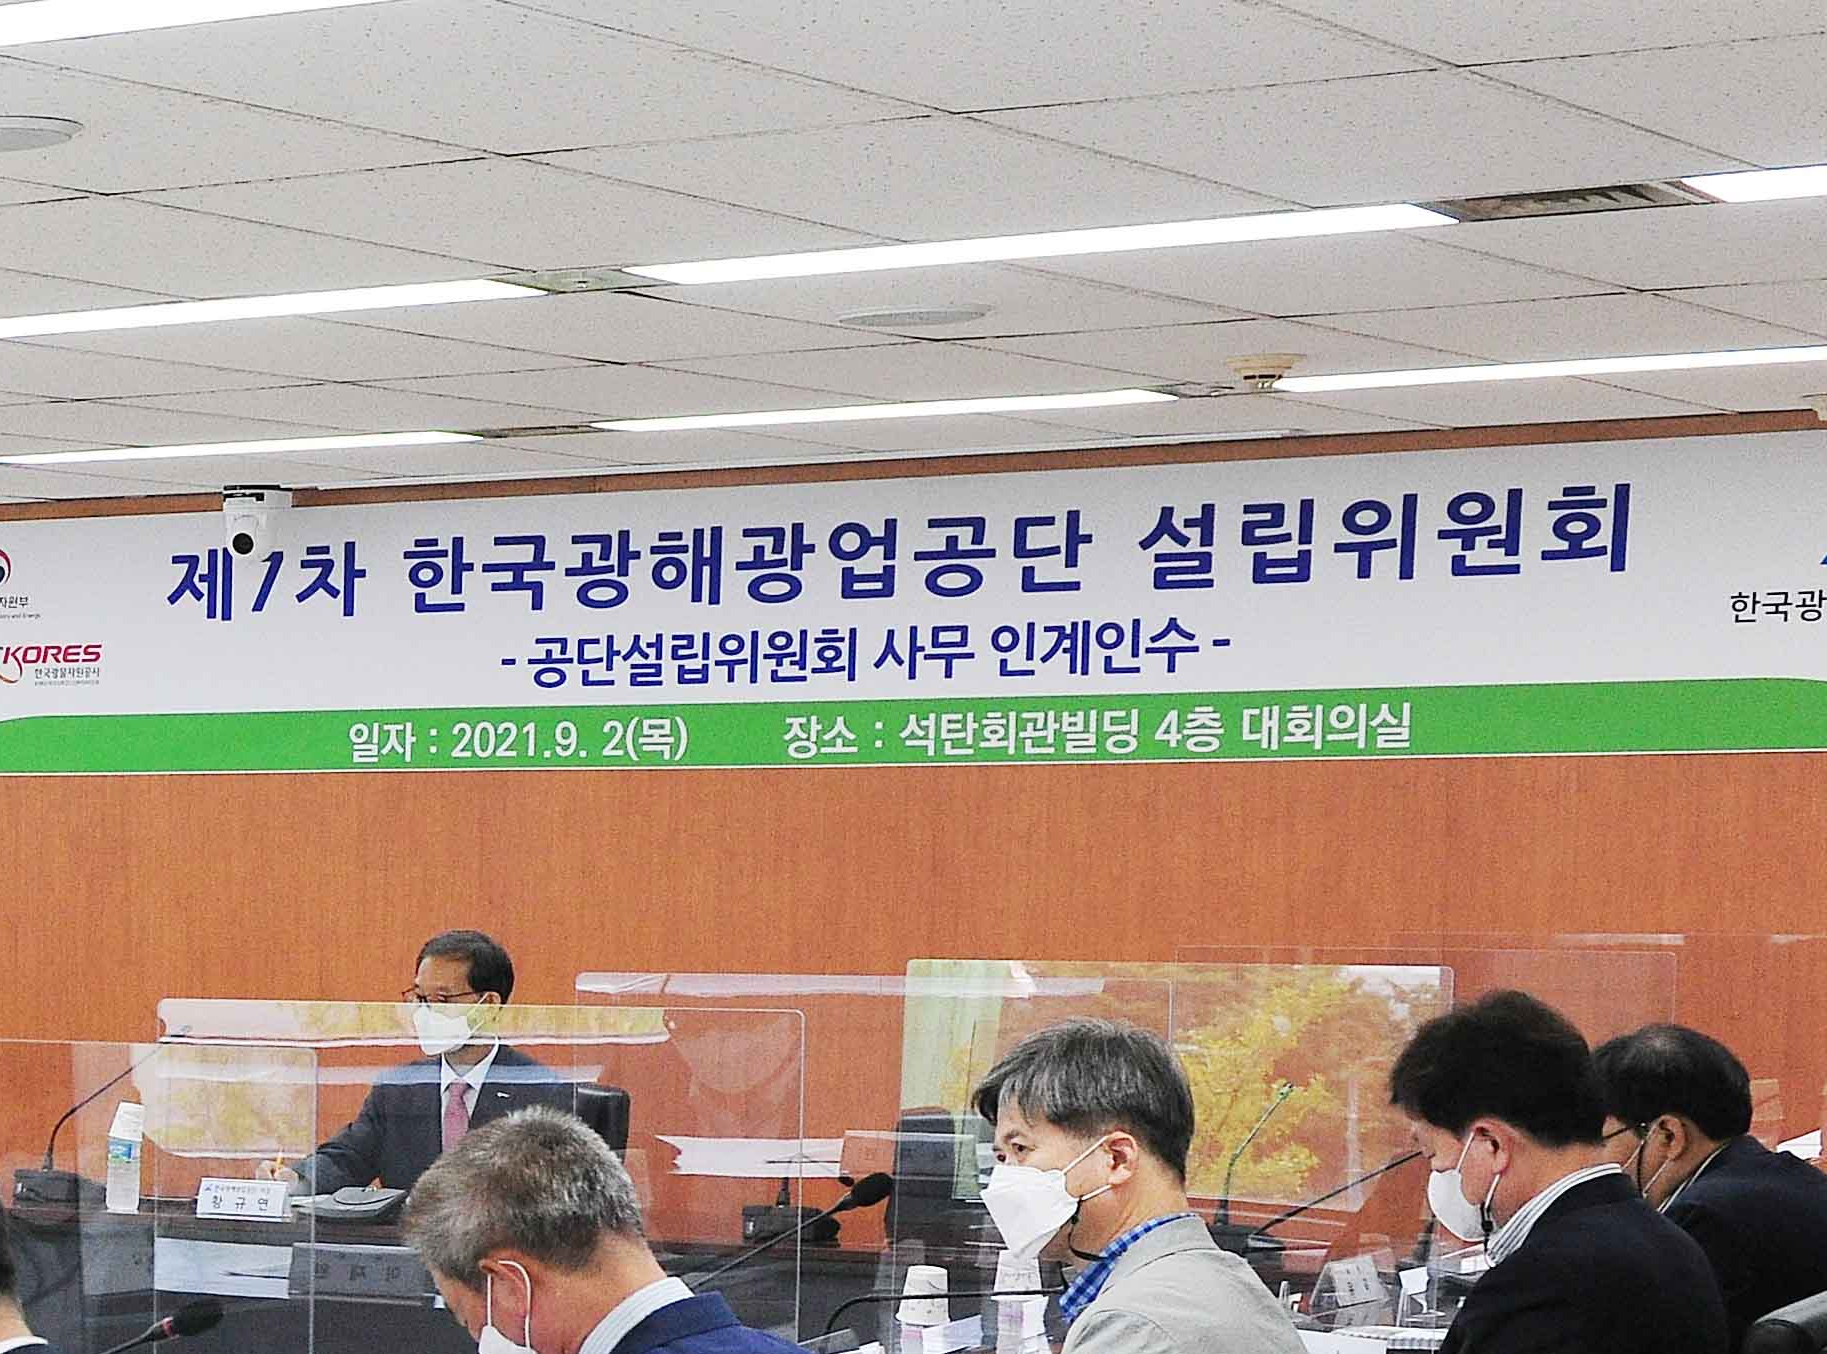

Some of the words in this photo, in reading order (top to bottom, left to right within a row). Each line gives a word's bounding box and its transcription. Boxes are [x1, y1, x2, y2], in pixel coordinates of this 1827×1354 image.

[167, 541, 367, 621] 제1차
[403, 510, 1093, 614] 한국광해광업공단
[1139, 483, 1630, 590] 설립위원회
[2, 644, 102, 666] KORES
[873, 625, 975, 681] 사무
[349, 721, 417, 759] 일자
[783, 715, 859, 759] 장소
[899, 708, 1139, 756] 석탄회관빌딩
[1154, 706, 1224, 753] 4층
[1242, 702, 1411, 751] 대회의실
